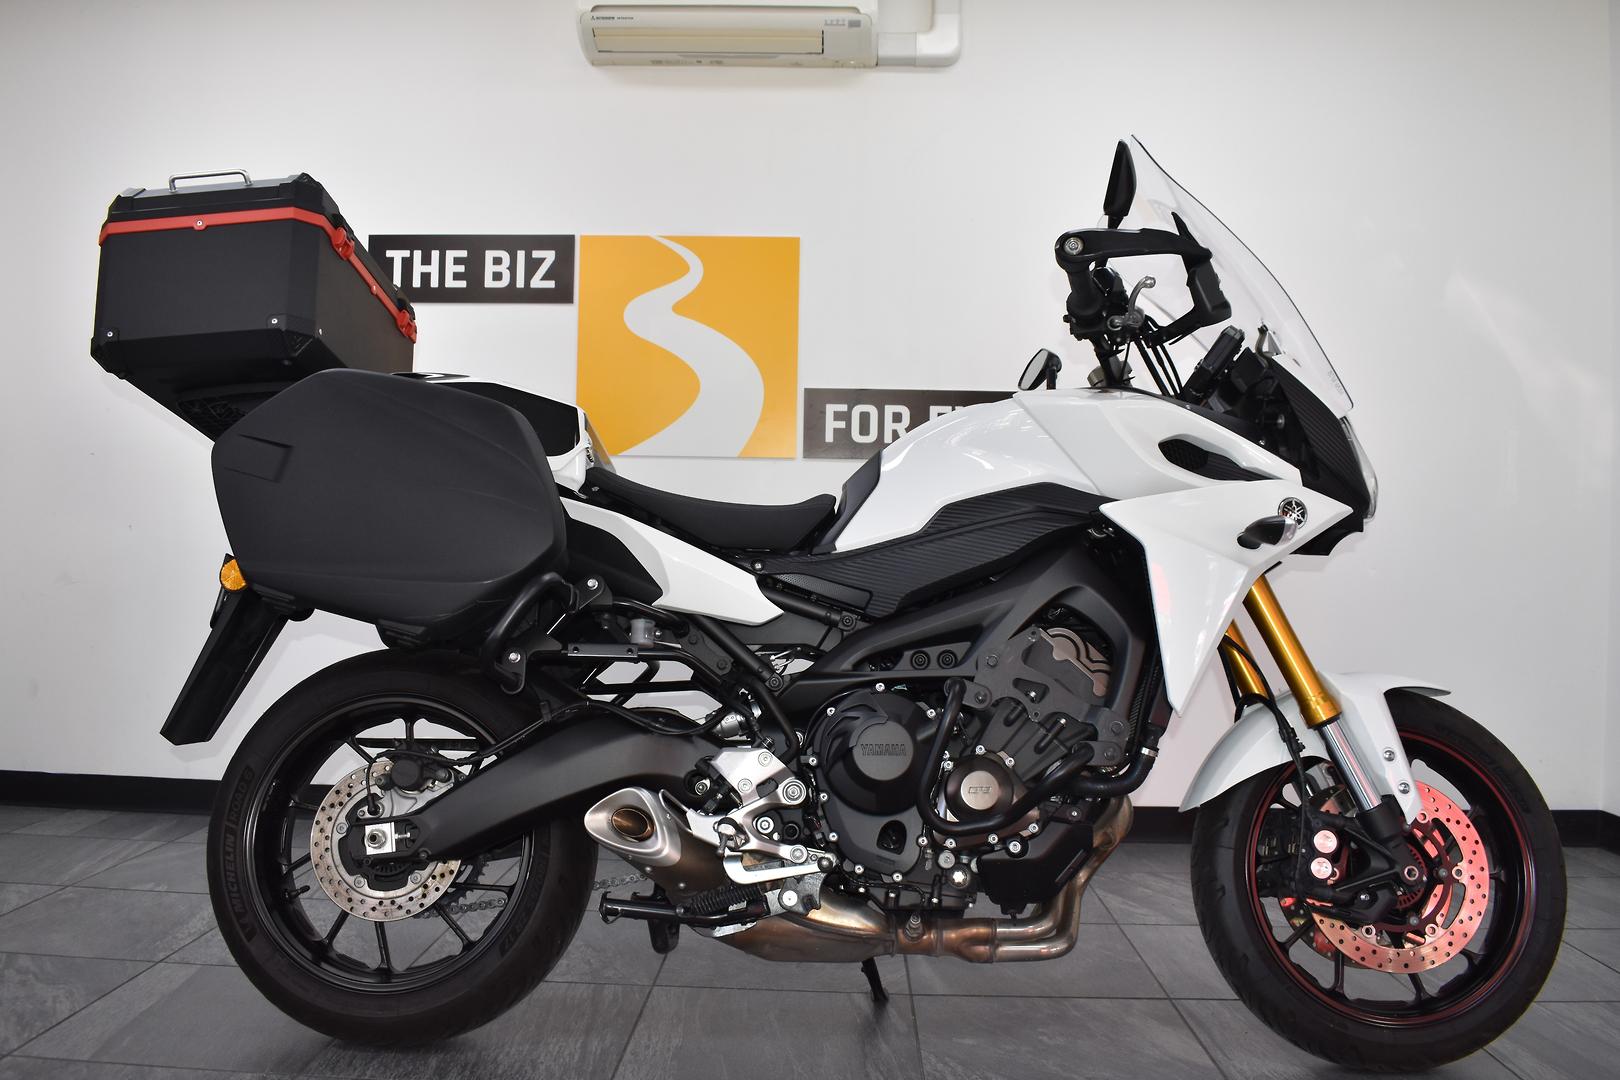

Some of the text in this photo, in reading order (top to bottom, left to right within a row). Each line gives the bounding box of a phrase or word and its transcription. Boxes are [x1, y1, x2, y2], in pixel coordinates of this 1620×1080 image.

[385, 249, 556, 289] THE BIZ
[825, 403, 911, 444] FOR
[860, 743, 907, 756] YAMAHA
[228, 784, 249, 823] ROAD
[223, 833, 247, 913] MICHELIN
